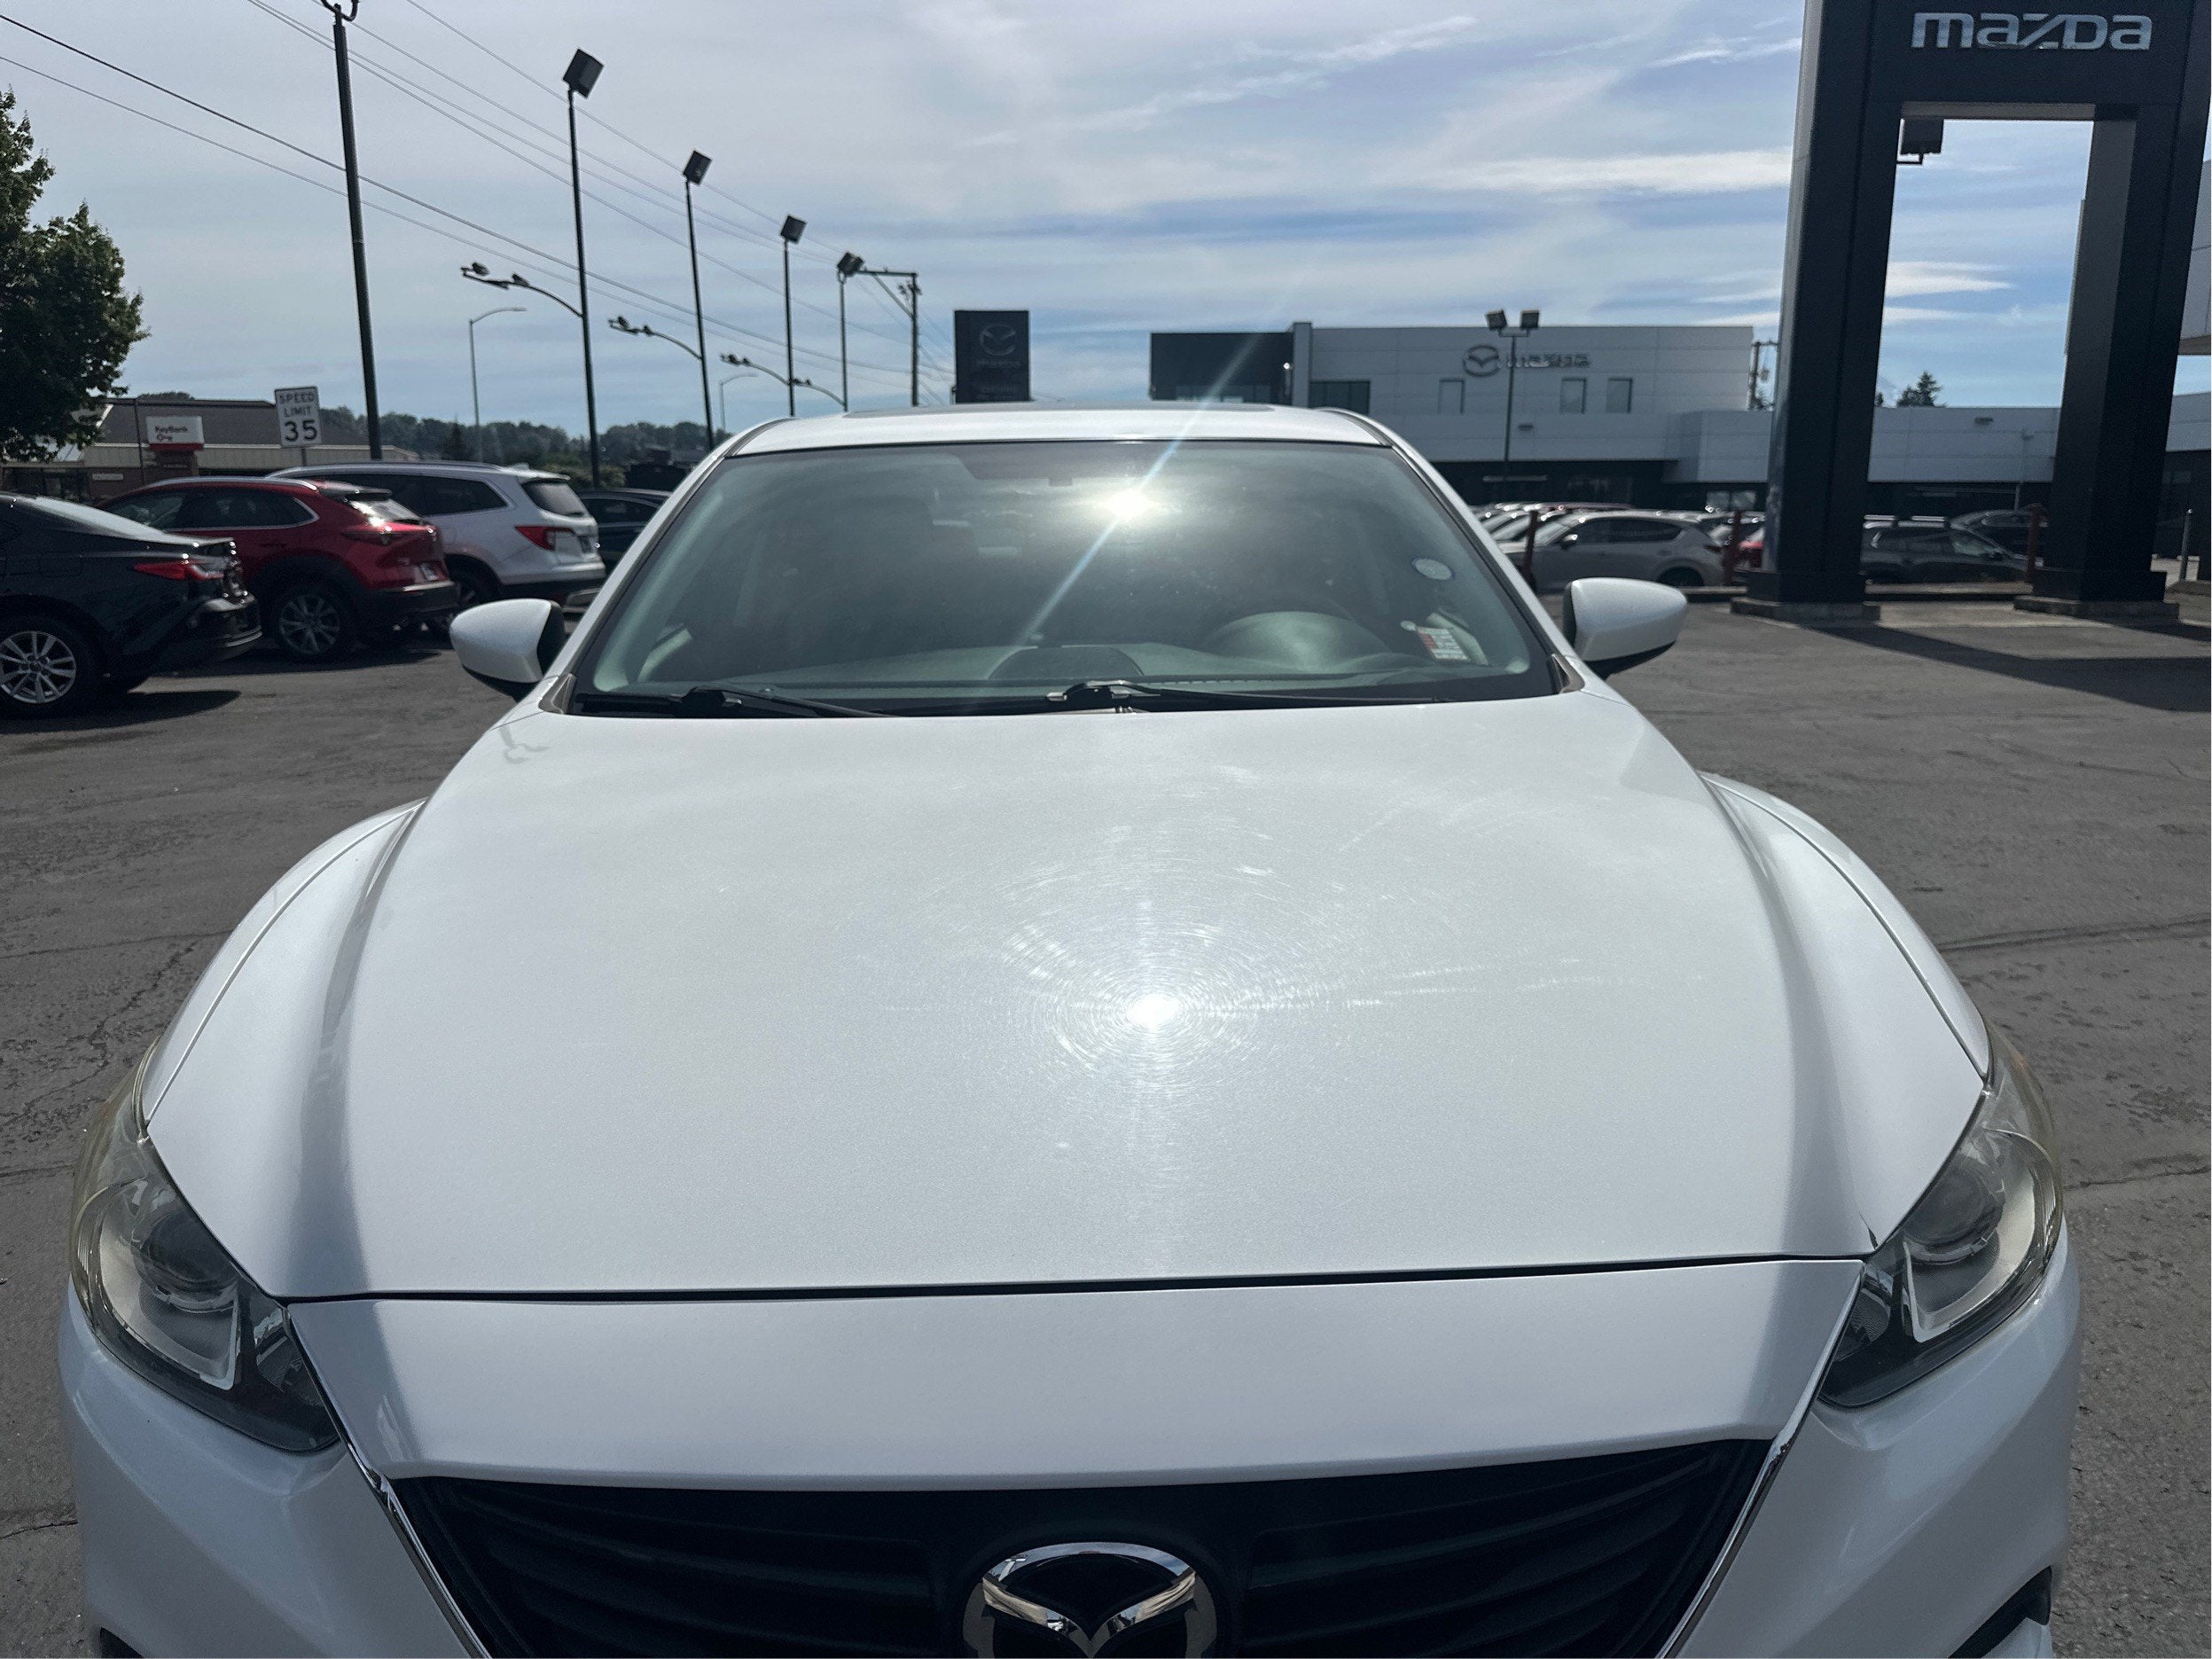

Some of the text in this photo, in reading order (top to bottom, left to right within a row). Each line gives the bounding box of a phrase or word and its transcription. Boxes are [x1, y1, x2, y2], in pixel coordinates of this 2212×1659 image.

[1911, 12, 2153, 51] mazda
[279, 391, 315, 404] SPEED
[284, 405, 312, 418] LIMIT
[284, 419, 318, 442] 35
